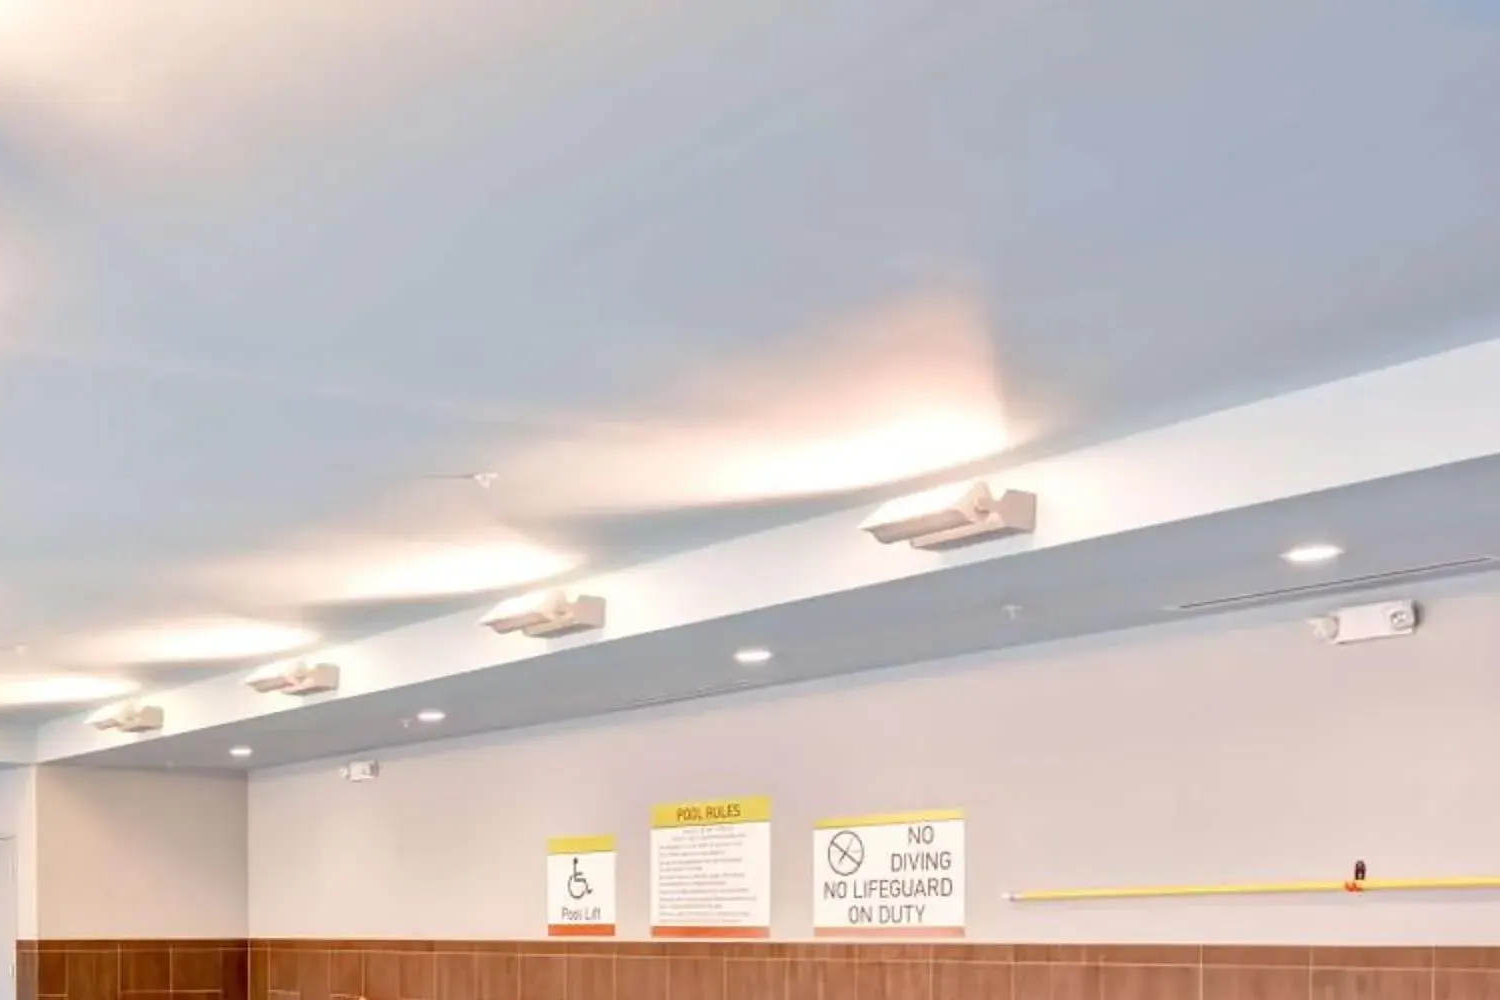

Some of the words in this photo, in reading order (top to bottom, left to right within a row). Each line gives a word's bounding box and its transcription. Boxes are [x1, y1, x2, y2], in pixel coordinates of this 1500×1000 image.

[676, 807, 704, 821] POOL
[706, 804, 741, 818] RULES
[908, 825, 934, 845] NO
[891, 851, 952, 872] DIVING
[823, 880, 847, 899] NO
[853, 877, 953, 899] LIFEGUARD
[561, 906, 583, 921] Pool
[584, 906, 601, 921] Lift
[848, 904, 872, 924] ON
[879, 904, 925, 924] DUTY
